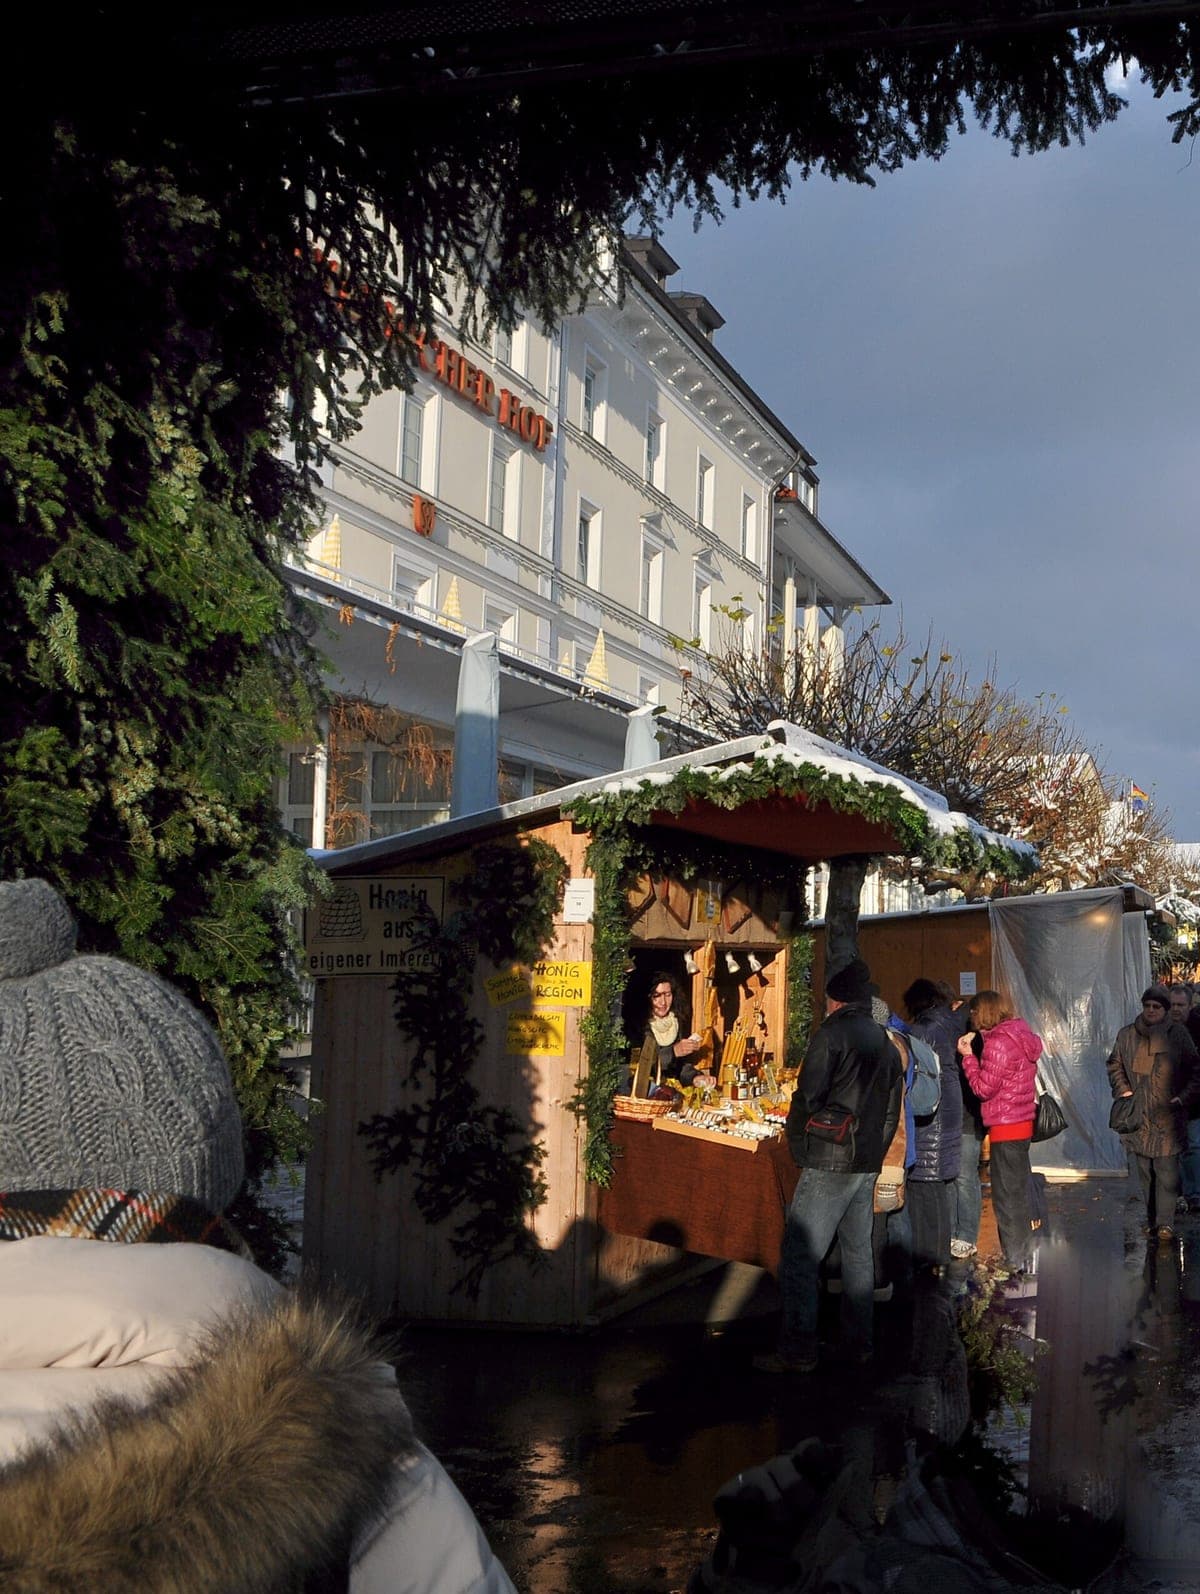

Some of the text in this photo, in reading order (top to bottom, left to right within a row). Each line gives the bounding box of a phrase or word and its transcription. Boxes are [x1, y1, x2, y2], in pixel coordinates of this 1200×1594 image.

[498, 389, 554, 453] HOF
[369, 883, 428, 910] Honig
[384, 921, 414, 938] aus
[310, 949, 434, 972] eigener Imkerei
